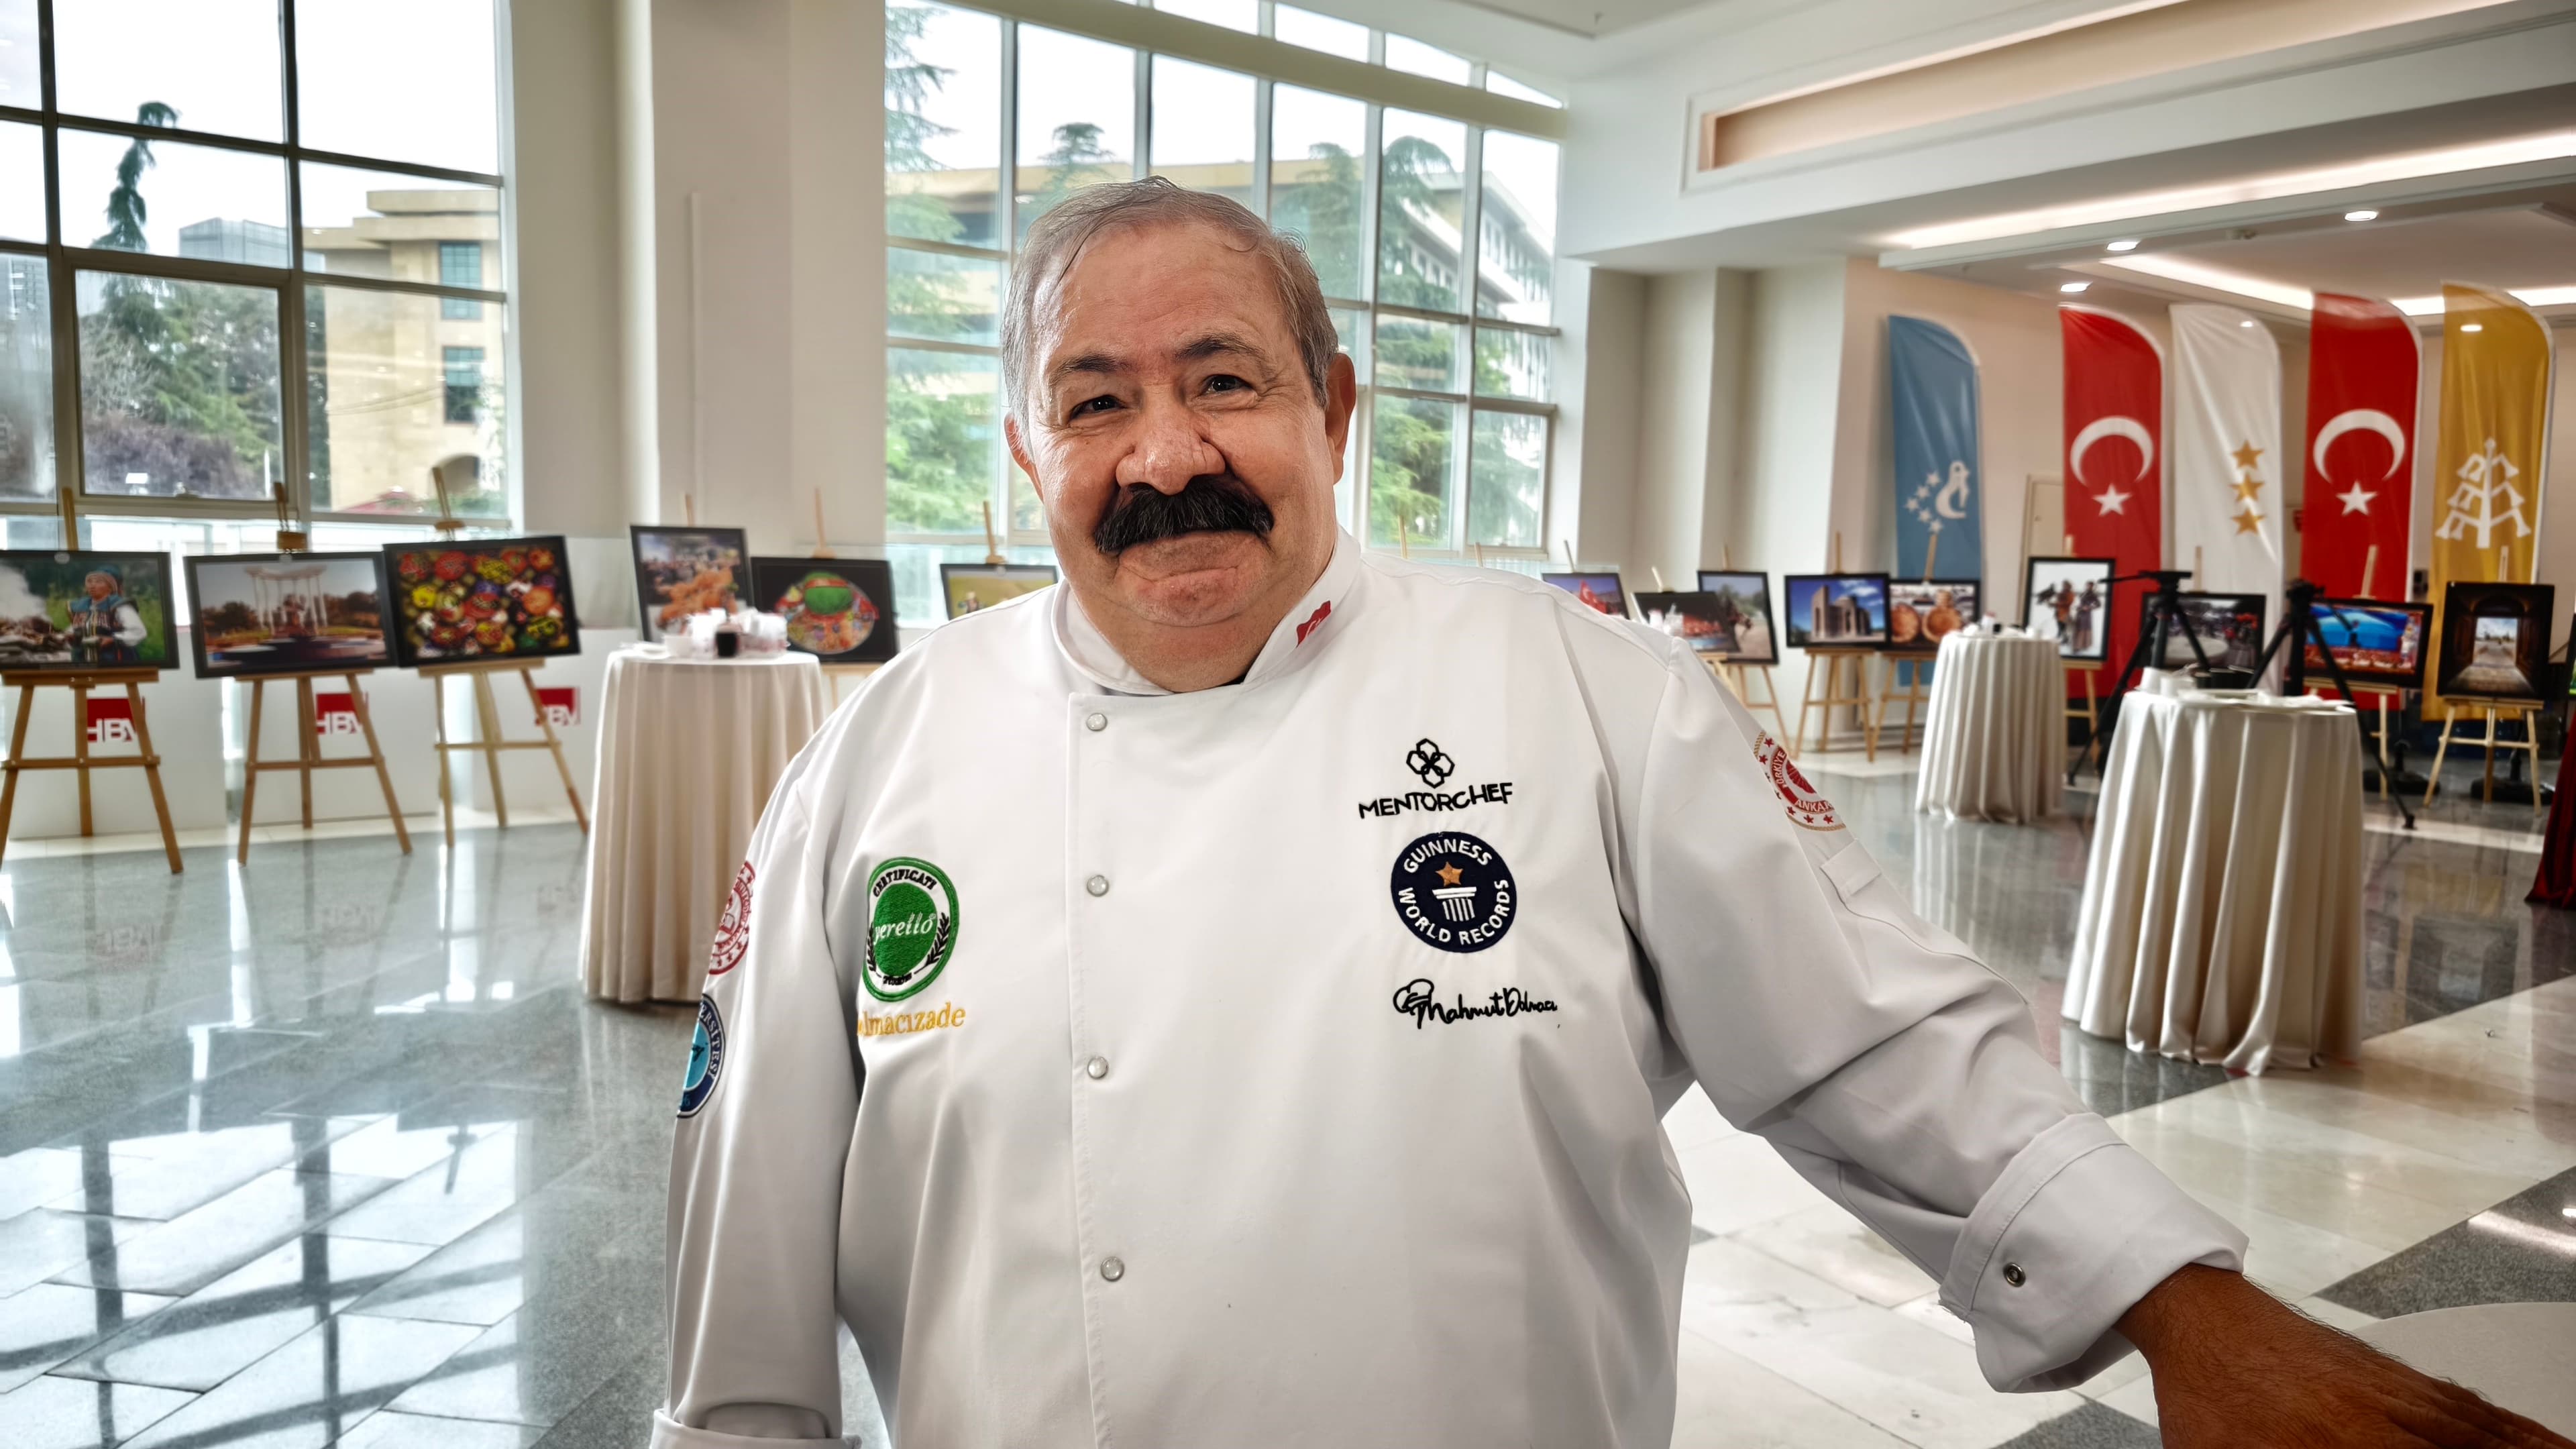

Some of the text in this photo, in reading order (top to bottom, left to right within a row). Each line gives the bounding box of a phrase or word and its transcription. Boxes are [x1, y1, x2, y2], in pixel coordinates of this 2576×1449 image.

[1358, 782, 1513, 819] MENTORCHEF
[1403, 839, 1493, 873] GUINNESS
[1399, 879, 1509, 945] WORLD RECORDS
[1409, 991, 1505, 1030] Mahmut
